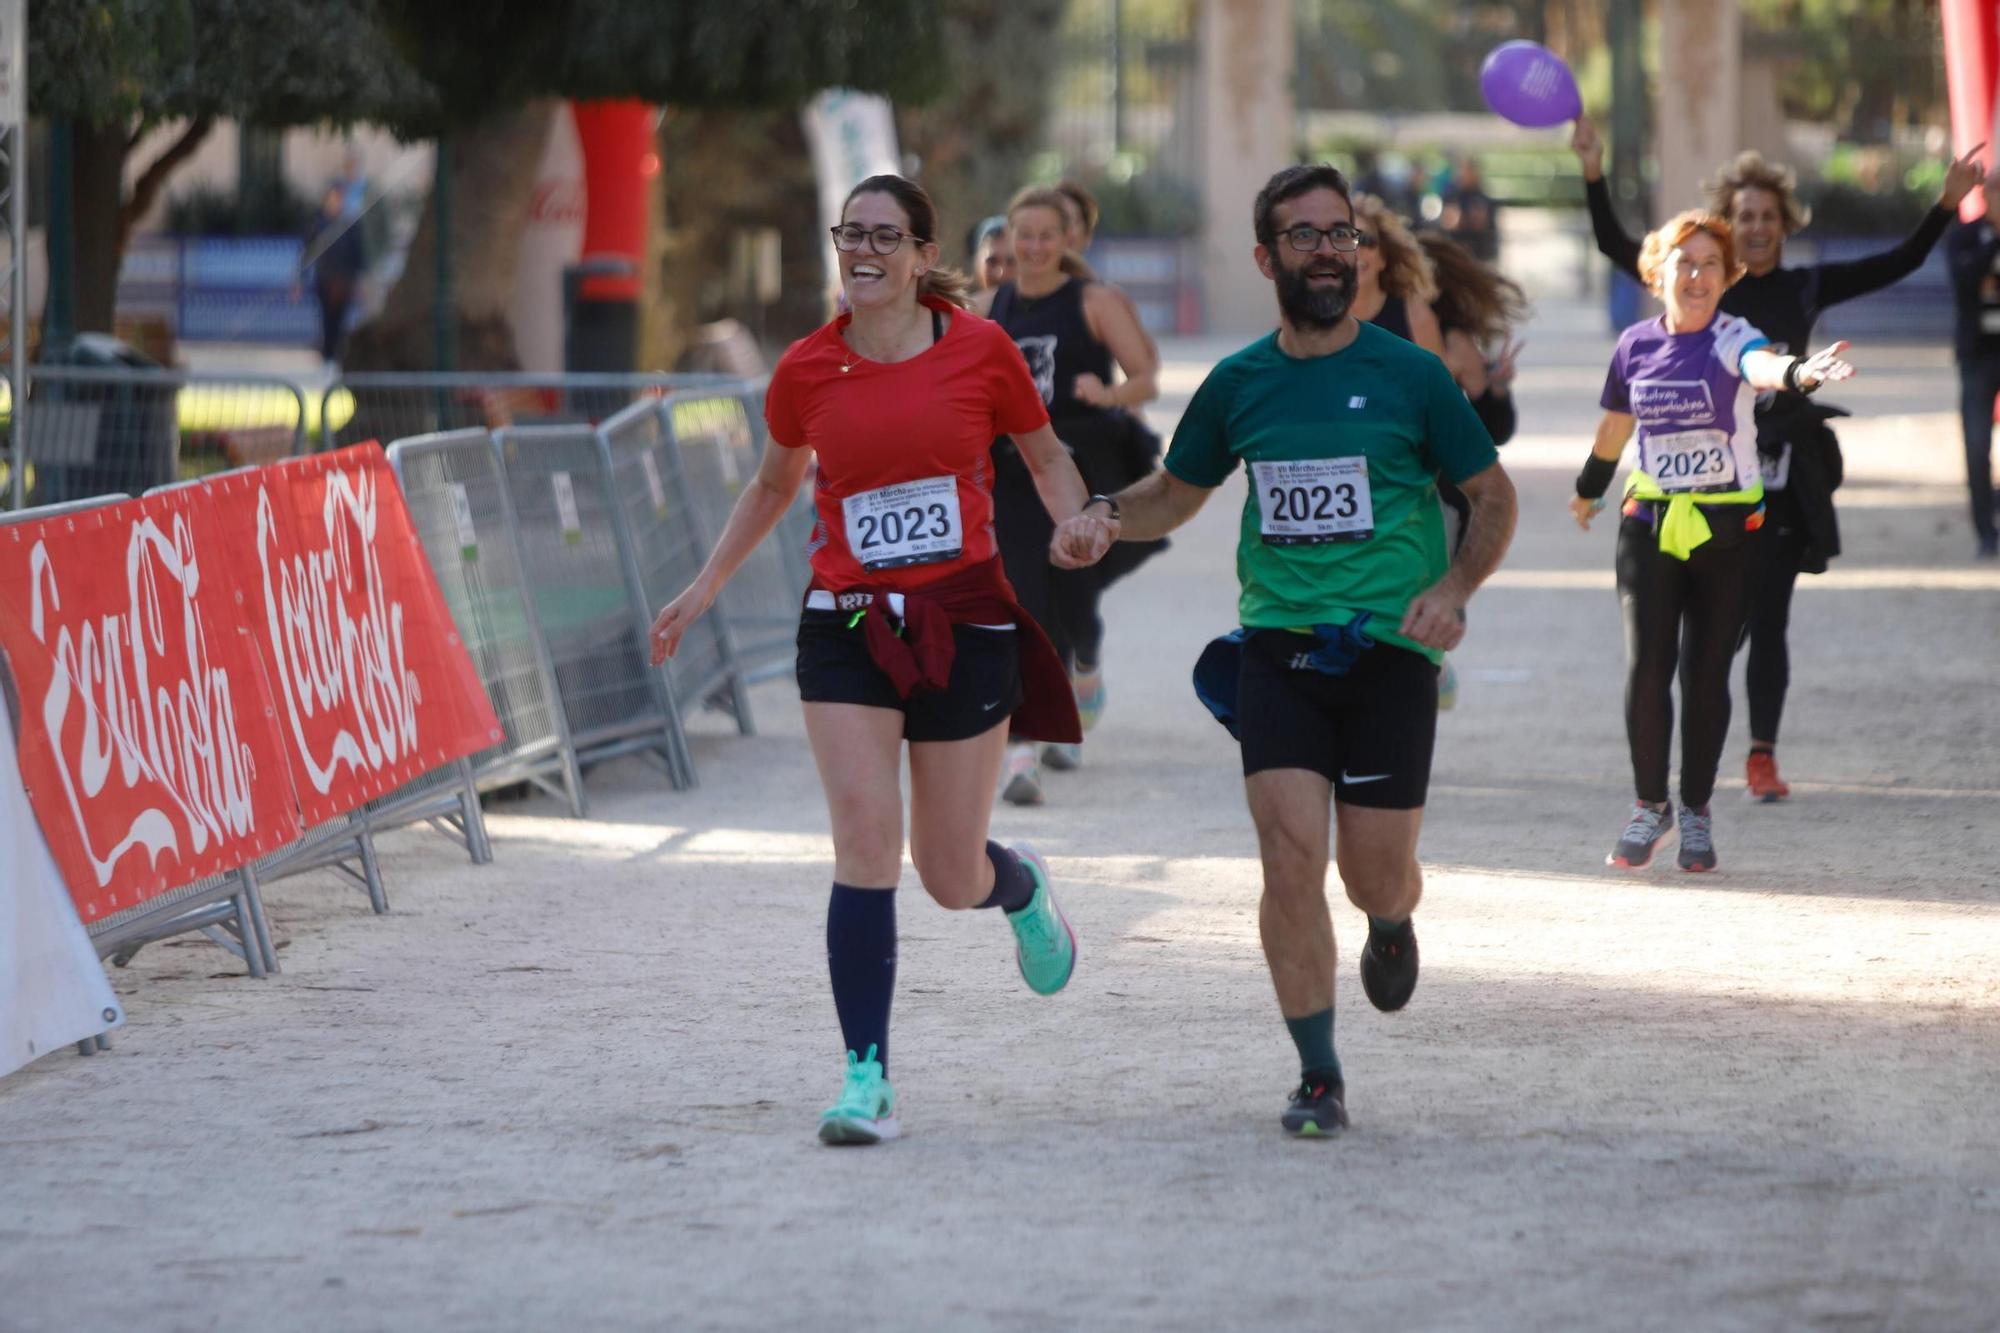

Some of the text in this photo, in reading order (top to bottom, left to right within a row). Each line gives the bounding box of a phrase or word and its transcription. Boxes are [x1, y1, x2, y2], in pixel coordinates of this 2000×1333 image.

[1656, 447, 1724, 479] 2023
[879, 486, 907, 498] Marcha
[1269, 483, 1359, 522] 2023
[857, 502, 951, 550] 2023
